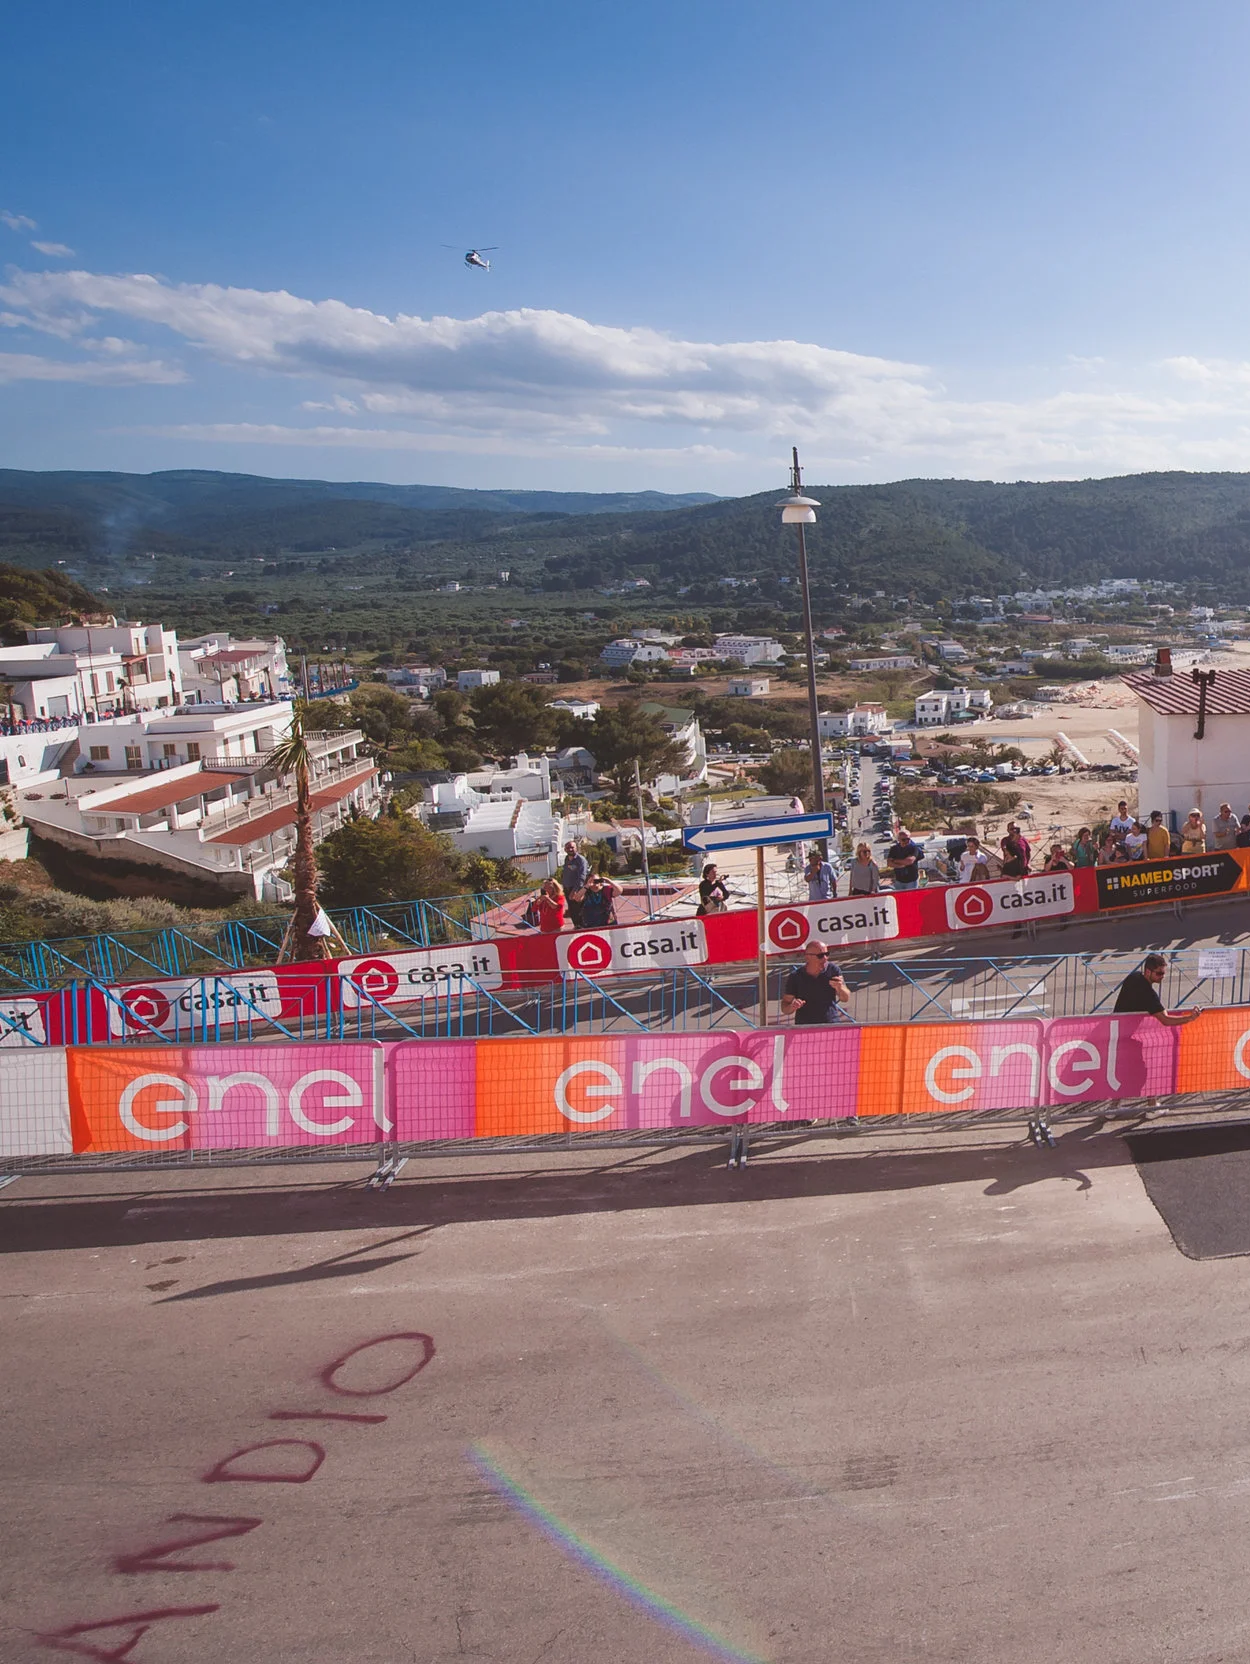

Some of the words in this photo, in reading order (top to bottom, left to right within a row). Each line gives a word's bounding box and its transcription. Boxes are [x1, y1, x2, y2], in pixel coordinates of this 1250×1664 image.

[1120, 863, 1220, 888] NAMEDSPORT
[1133, 882, 1198, 898] SUPERFOOD
[1000, 883, 1067, 909] casa.it
[817, 906, 890, 933] casa.it
[620, 930, 699, 959] casa.it
[407, 956, 491, 985] casa.it
[179, 982, 271, 1013] casa.it
[0, 1010, 32, 1034] .it
[924, 1019, 1121, 1105] enel
[554, 1034, 790, 1124] enel
[118, 1047, 394, 1142] enel
